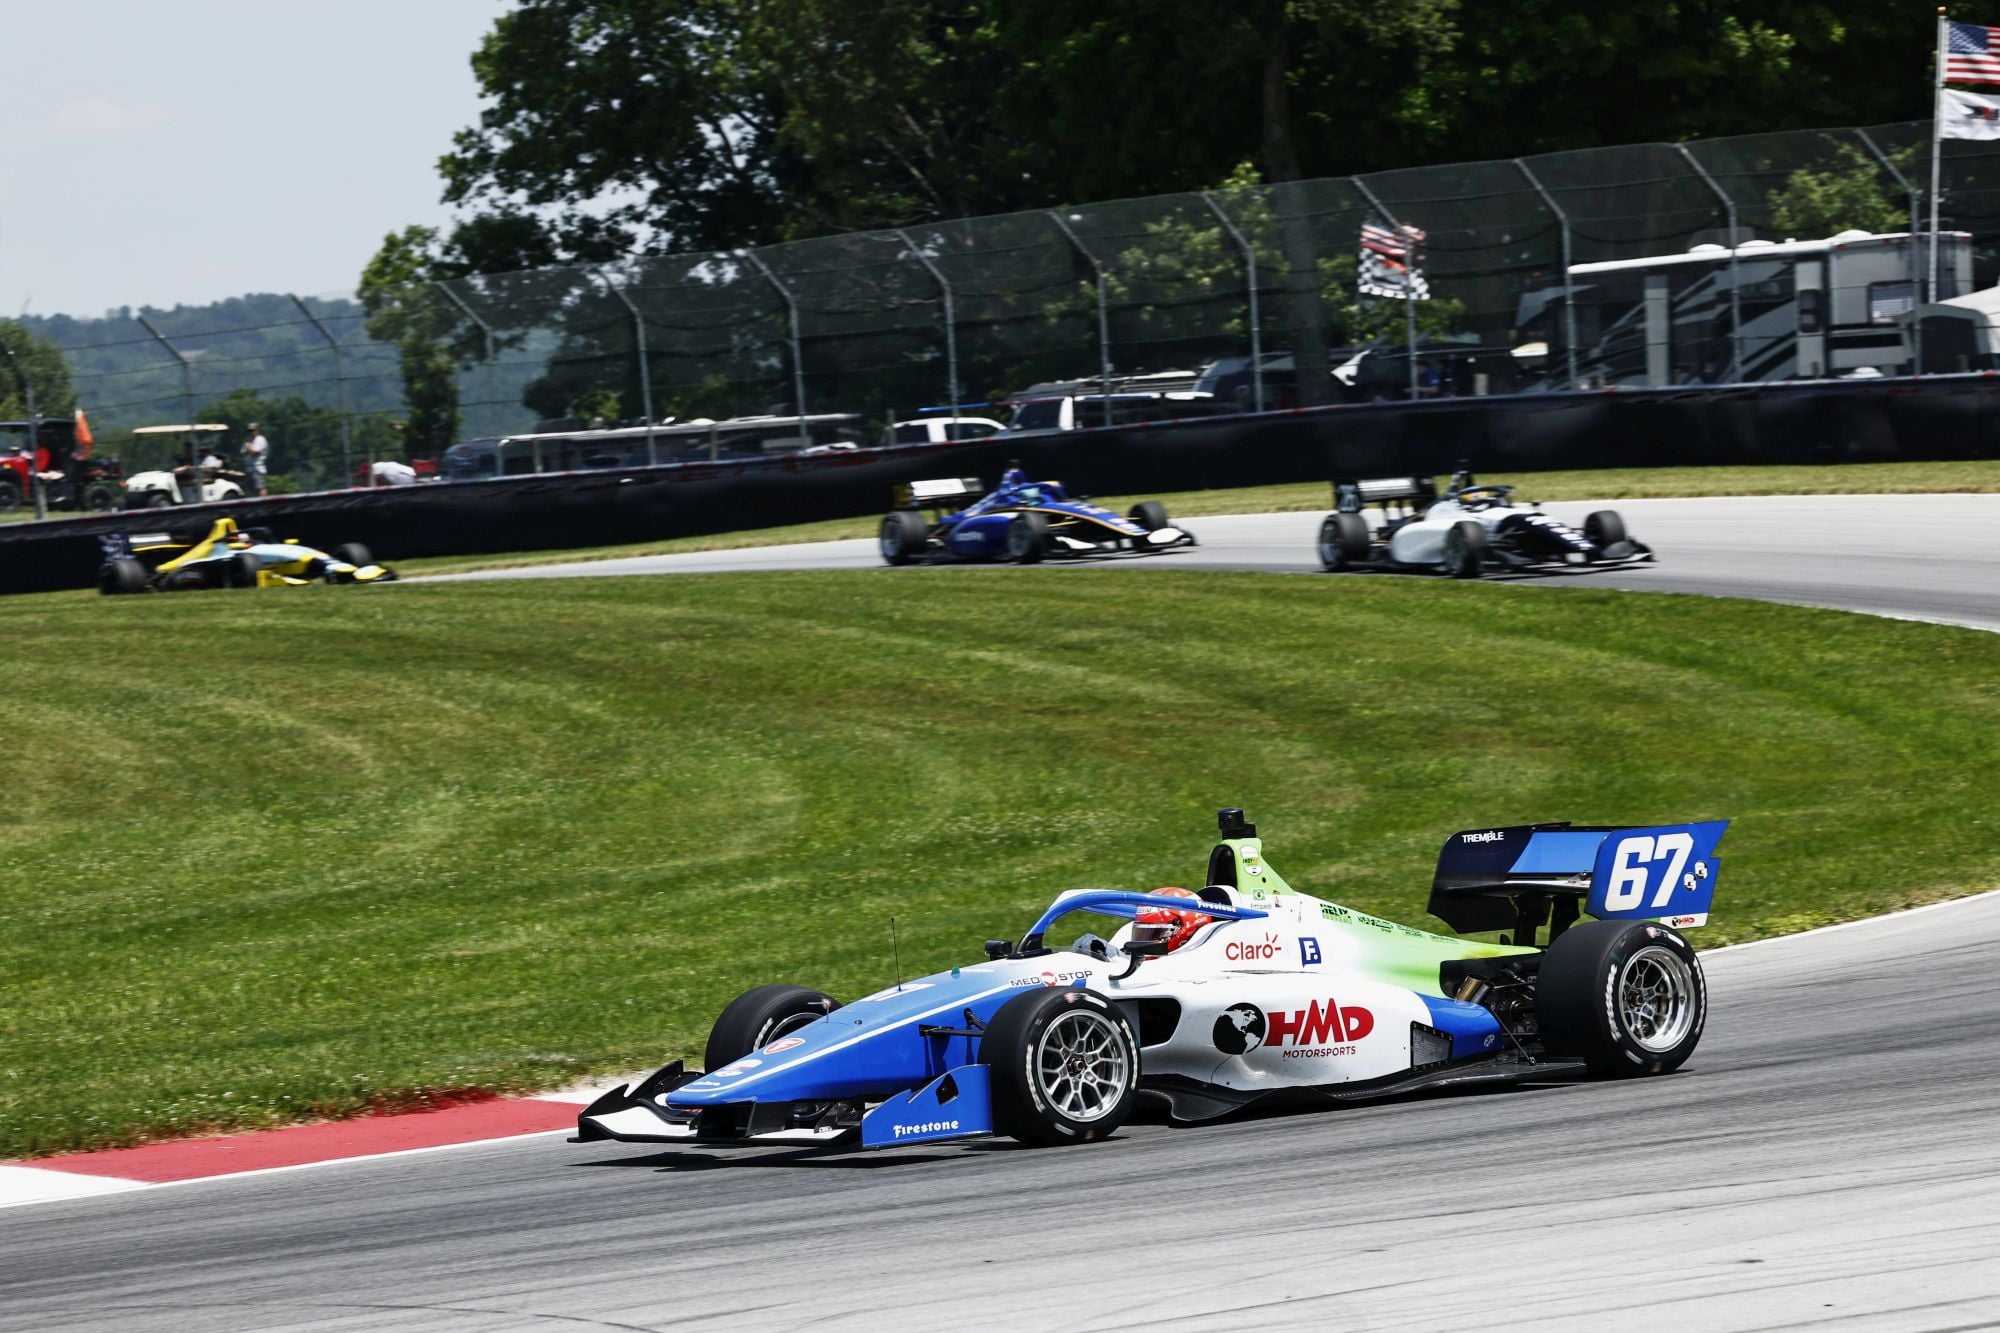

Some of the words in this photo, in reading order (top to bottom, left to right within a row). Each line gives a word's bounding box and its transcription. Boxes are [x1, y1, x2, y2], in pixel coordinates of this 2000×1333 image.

[1461, 831, 1505, 843] TREMBLE
[1605, 833, 1694, 912] 67
[1197, 900, 1237, 913] Firestone
[1226, 940, 1276, 960] Claro
[1010, 976, 1041, 986] MED
[1058, 970, 1093, 981] STOP
[1263, 998, 1374, 1047] HMD
[1282, 1046, 1356, 1058] MOTORSPORTS
[893, 1120, 959, 1138] Firestone
